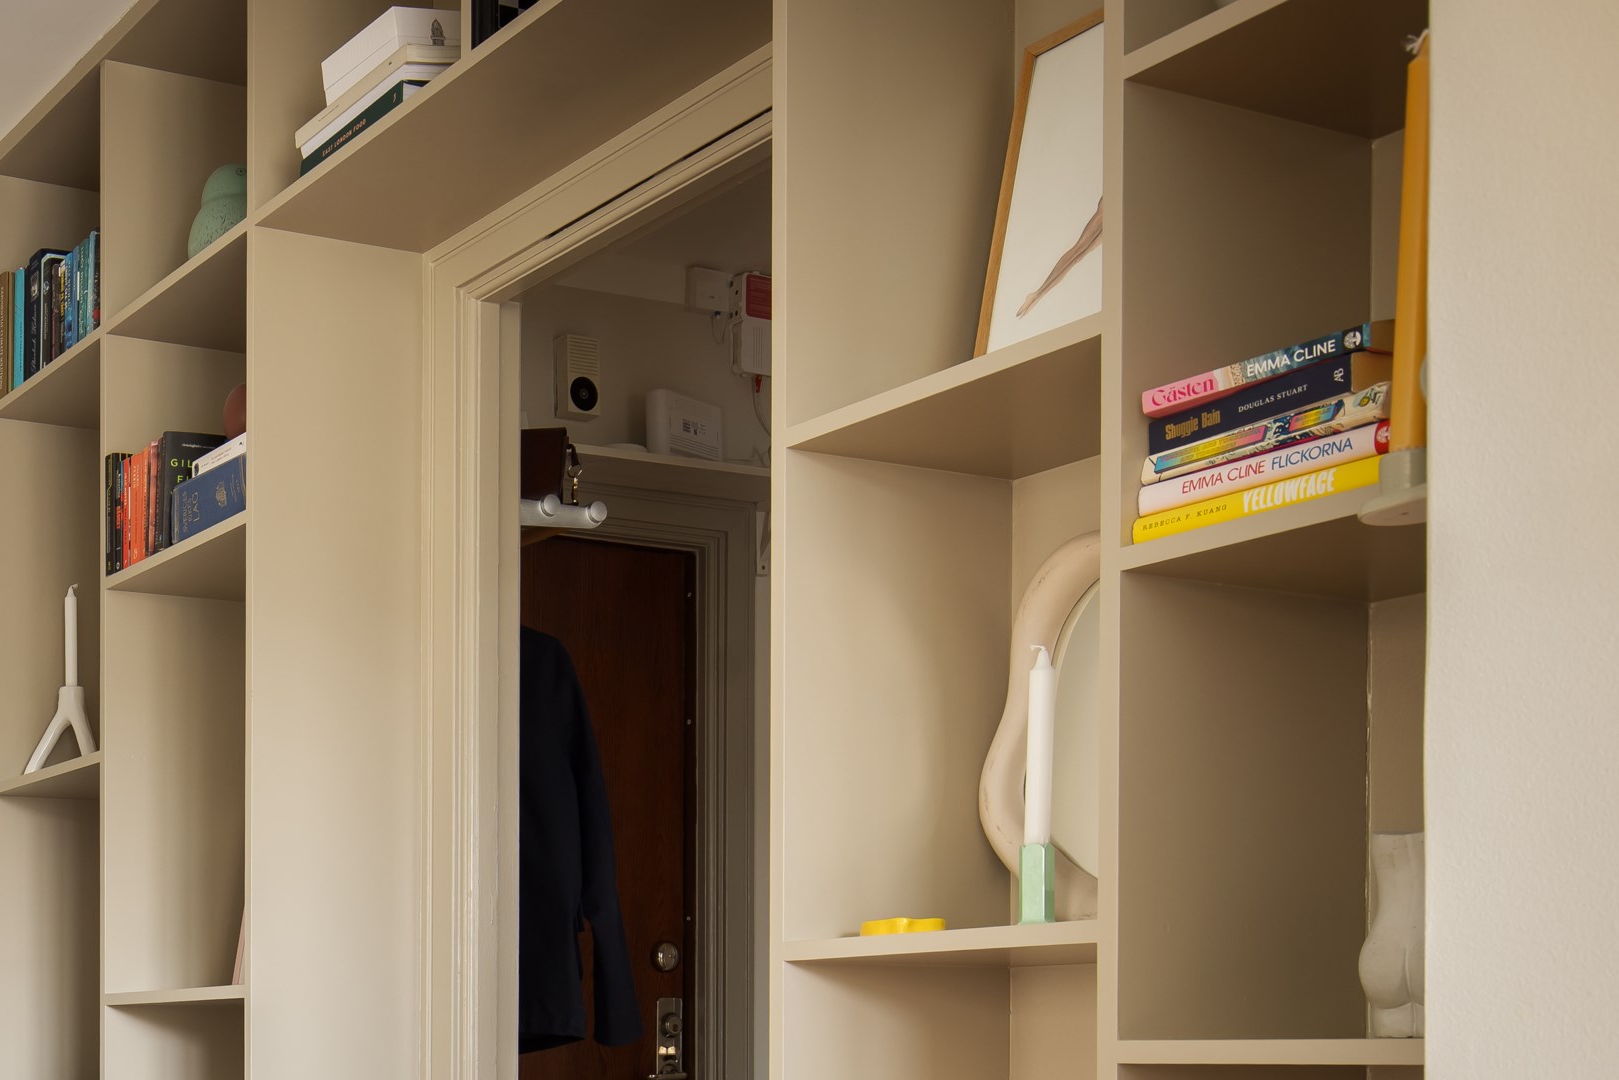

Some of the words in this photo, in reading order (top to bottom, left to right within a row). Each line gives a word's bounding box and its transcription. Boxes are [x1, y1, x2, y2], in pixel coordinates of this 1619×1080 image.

[322, 144, 333, 157] EAST
[334, 129, 352, 148] LONDON
[353, 118, 367, 133] FOOD
[1246, 354, 1290, 377] EMMA
[1293, 339, 1336, 363] CLINE
[1151, 376, 1215, 407] Gästen
[1237, 394, 1275, 413] DOUGLAS
[1275, 384, 1308, 402] STUART
[1165, 418, 1199, 441] Shuggie
[1201, 409, 1221, 430] Bain
[1181, 471, 1224, 494] EMMA
[1227, 460, 1266, 484] CLINE
[1270, 437, 1353, 470] FLICKORNA
[1242, 469, 1337, 513] YELLOWFACE
[192, 492, 200, 523] LAG
[1142, 515, 1182, 531] REBECCA
[1184, 512, 1193, 521] F.
[1196, 503, 1228, 518] KUANG
